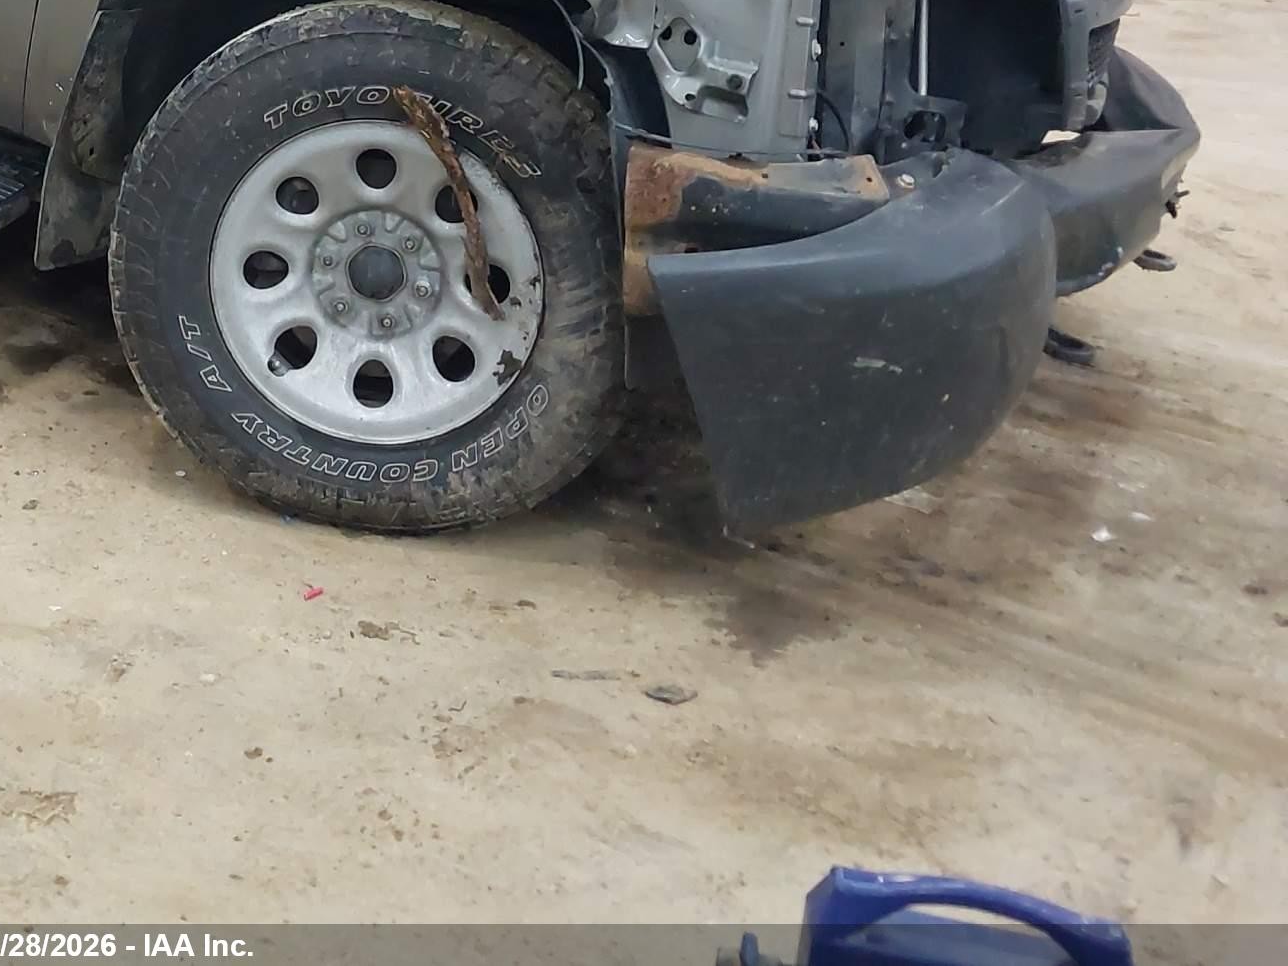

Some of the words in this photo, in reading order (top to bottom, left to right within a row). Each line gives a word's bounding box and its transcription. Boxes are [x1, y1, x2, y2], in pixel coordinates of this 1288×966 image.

[263, 85, 390, 130] TOYO
[178, 315, 233, 393] A/T
[231, 411, 440, 483] COUNTRY
[450, 384, 550, 472] OPEN
